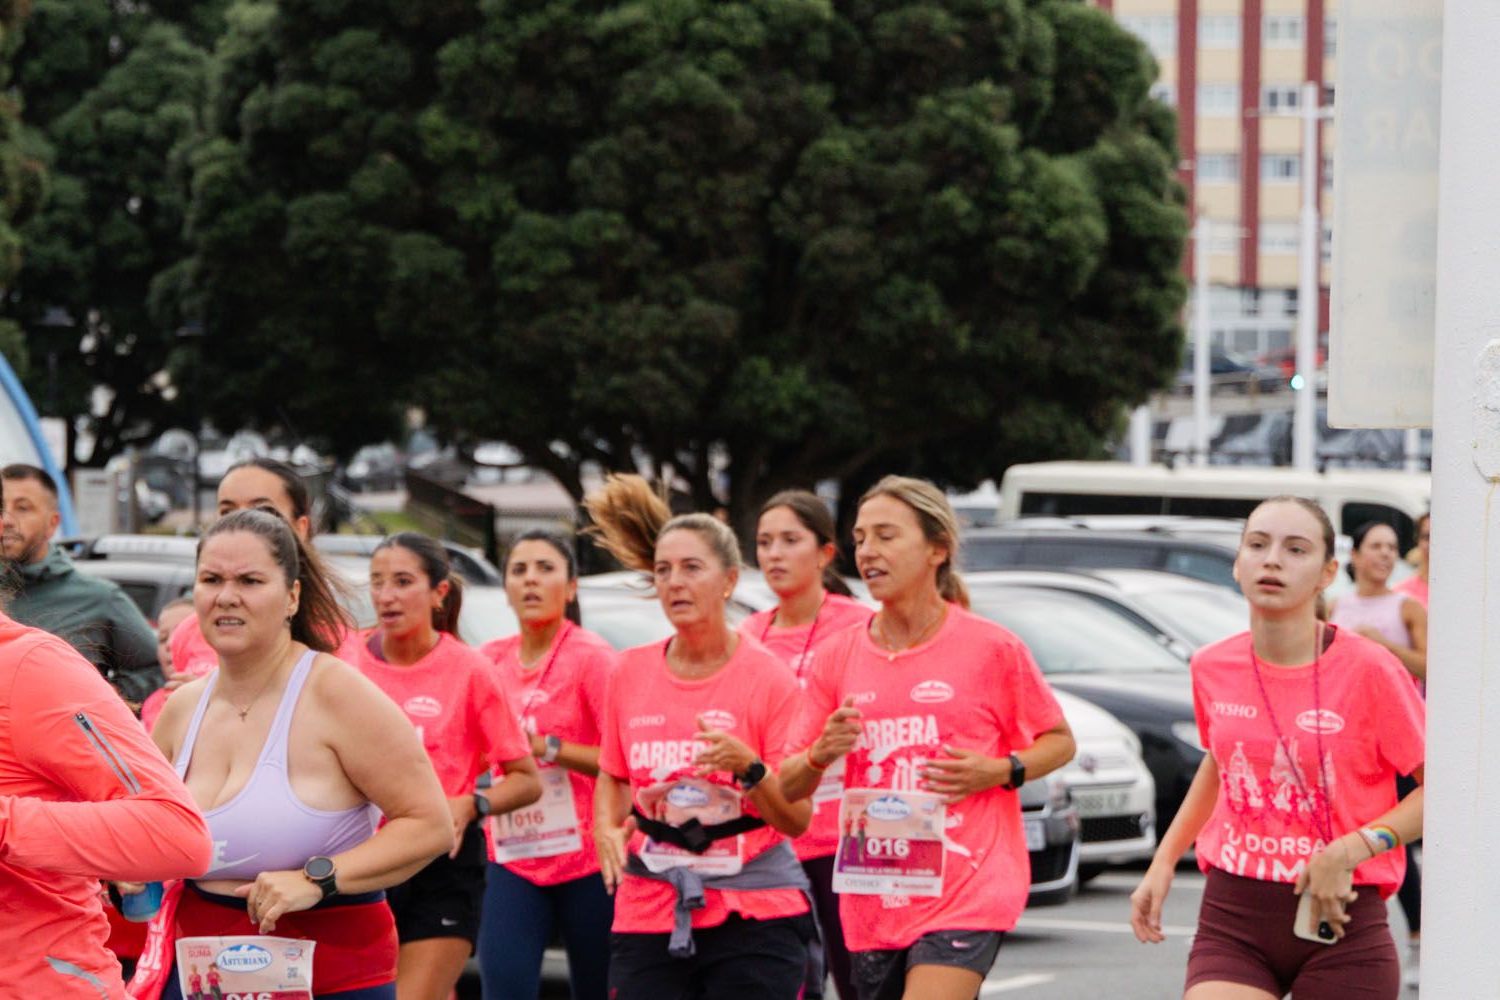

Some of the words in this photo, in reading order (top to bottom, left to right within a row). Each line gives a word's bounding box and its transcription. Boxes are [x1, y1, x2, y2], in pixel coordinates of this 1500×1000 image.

[851, 714, 939, 751] ARRERA
[514, 809, 544, 828] 016
[866, 838, 910, 857] 016
[1245, 833, 1327, 857] DORSA
